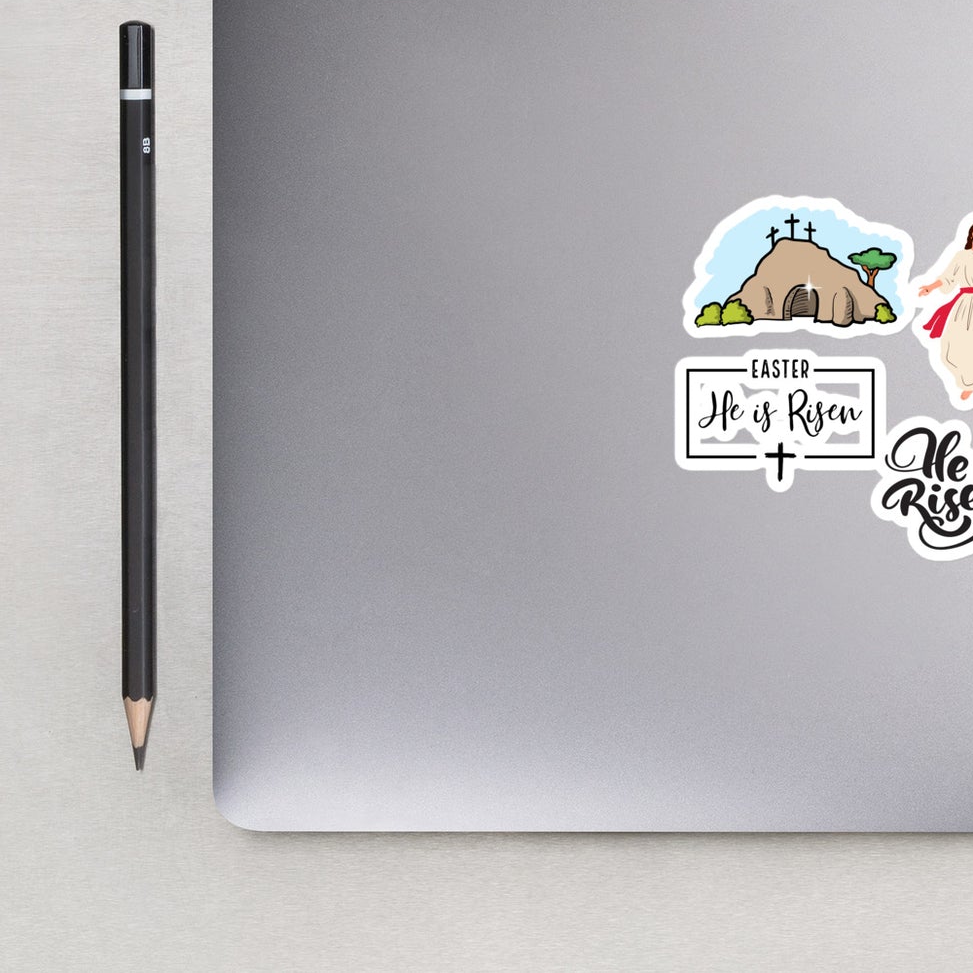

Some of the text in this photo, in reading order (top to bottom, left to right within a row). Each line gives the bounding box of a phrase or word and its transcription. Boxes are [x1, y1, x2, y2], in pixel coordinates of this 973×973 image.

[143, 137, 151, 154] 8B
[751, 359, 809, 379] EASTER
[698, 388, 863, 438] He is Risen
[884, 427, 969, 483] He
